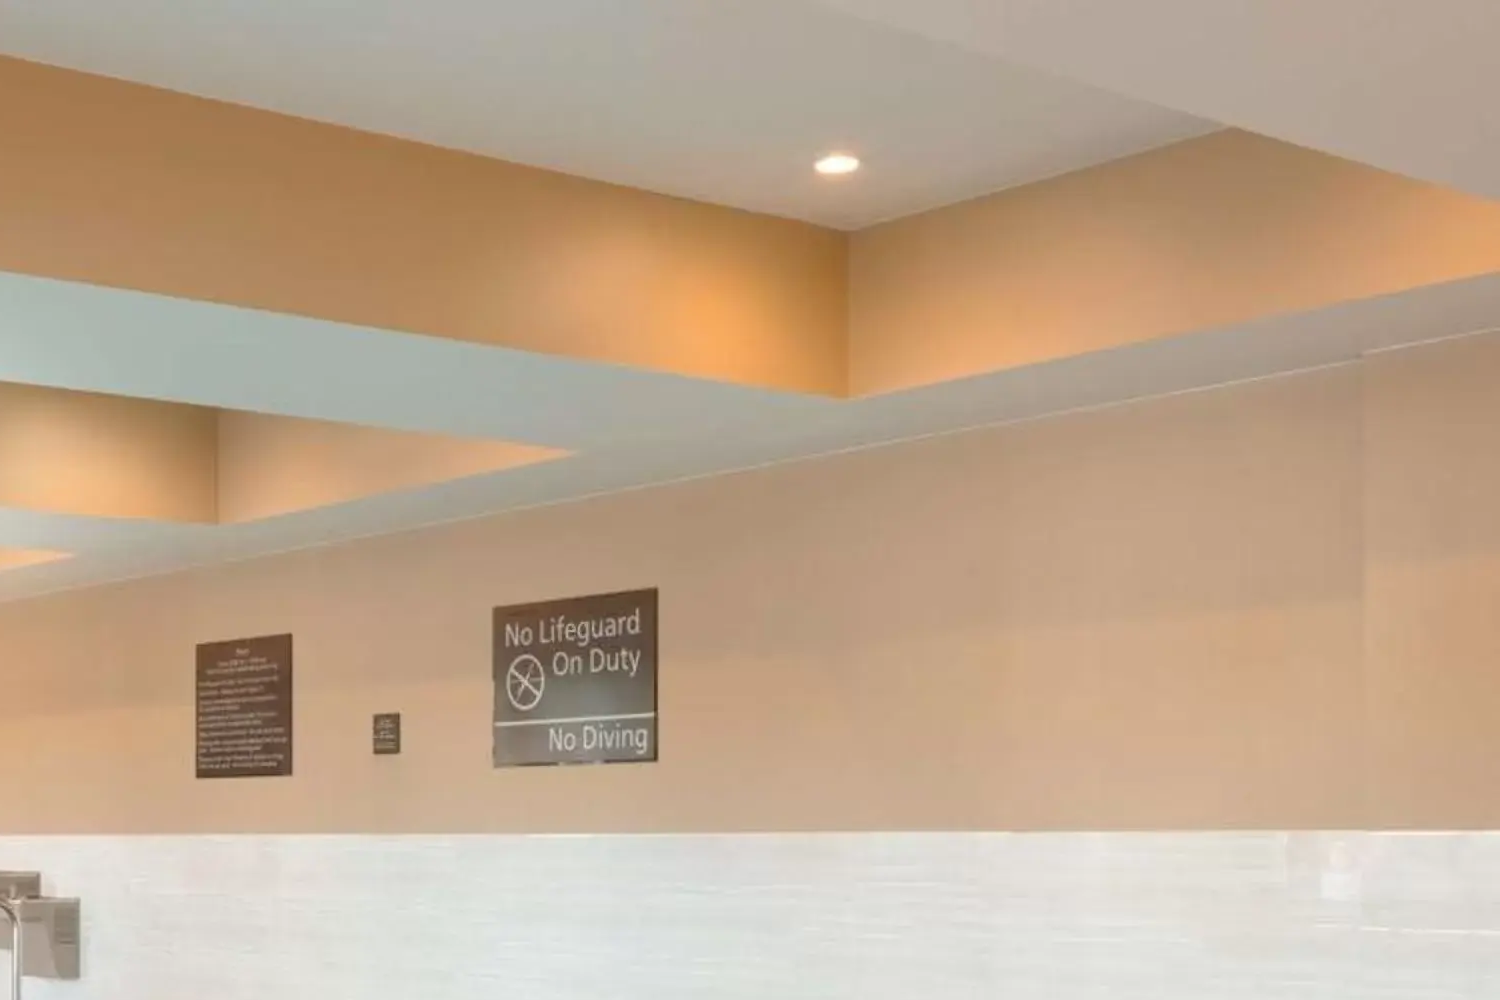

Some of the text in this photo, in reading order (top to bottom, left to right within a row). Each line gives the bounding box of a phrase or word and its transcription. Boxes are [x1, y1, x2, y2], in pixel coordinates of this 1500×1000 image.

[505, 608, 641, 647] No Lifeguard
[553, 648, 641, 677] On Duty
[549, 723, 648, 754] No Diving
